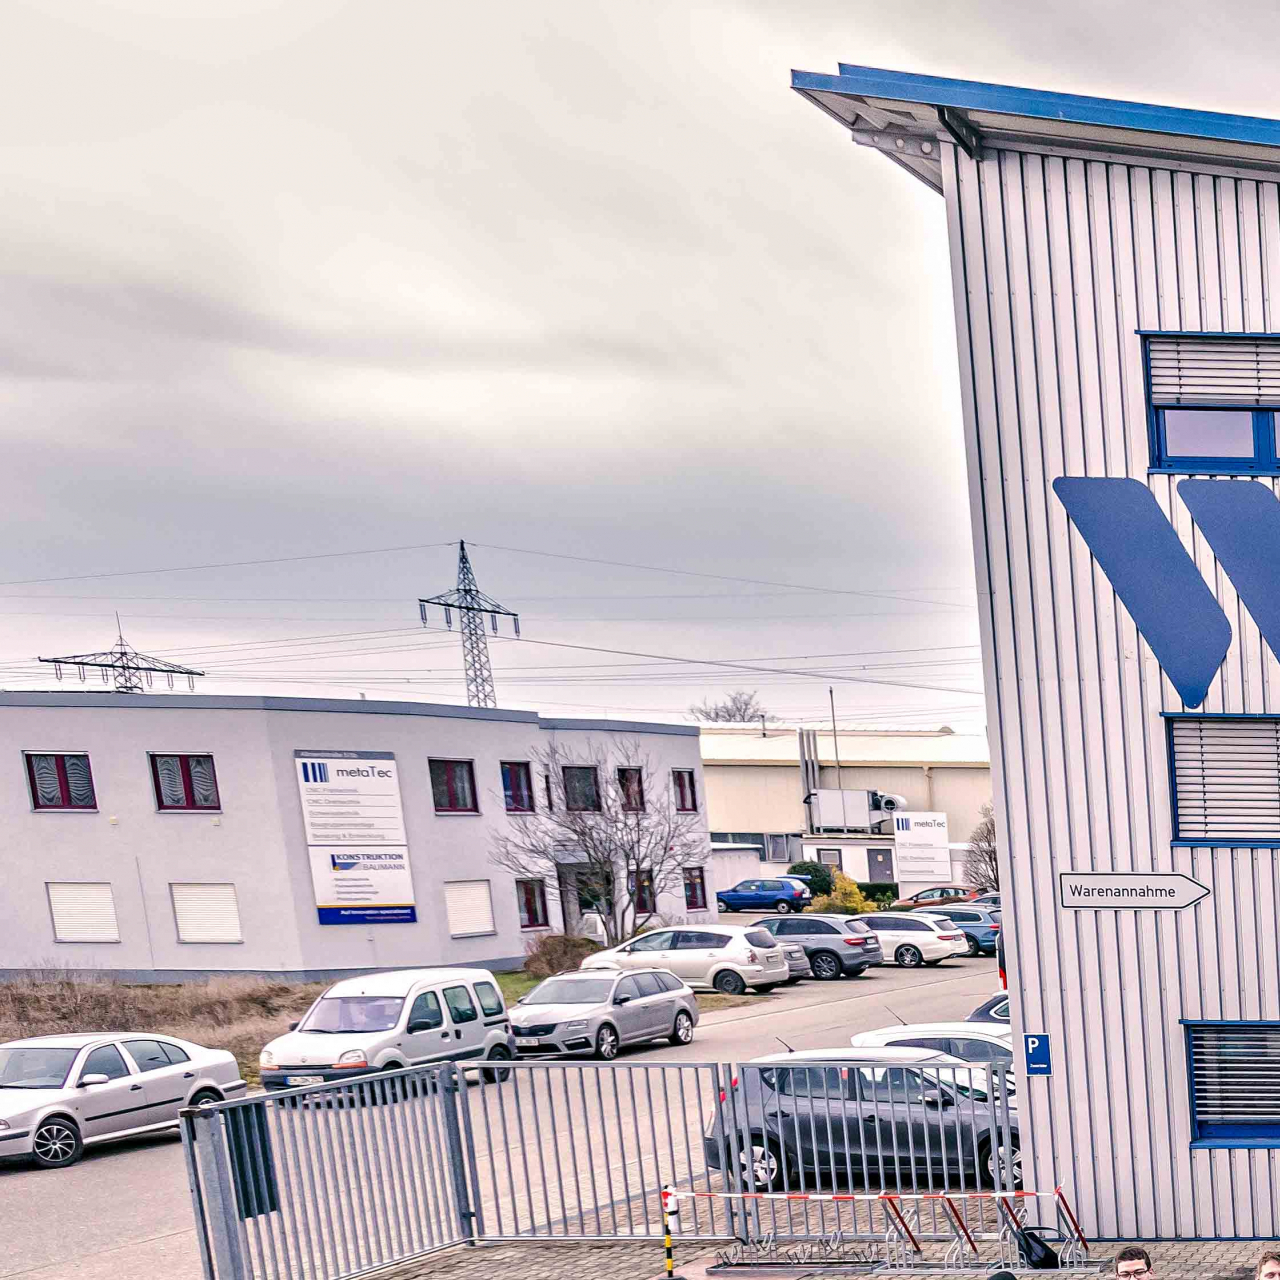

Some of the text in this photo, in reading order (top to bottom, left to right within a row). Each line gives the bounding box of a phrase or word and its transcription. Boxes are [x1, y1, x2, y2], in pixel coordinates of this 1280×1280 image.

[336, 766, 392, 778] metaTec
[914, 820, 946, 828] metaTec
[1069, 884, 1176, 898] Warenannahme
[1028, 1037, 1039, 1053] P
